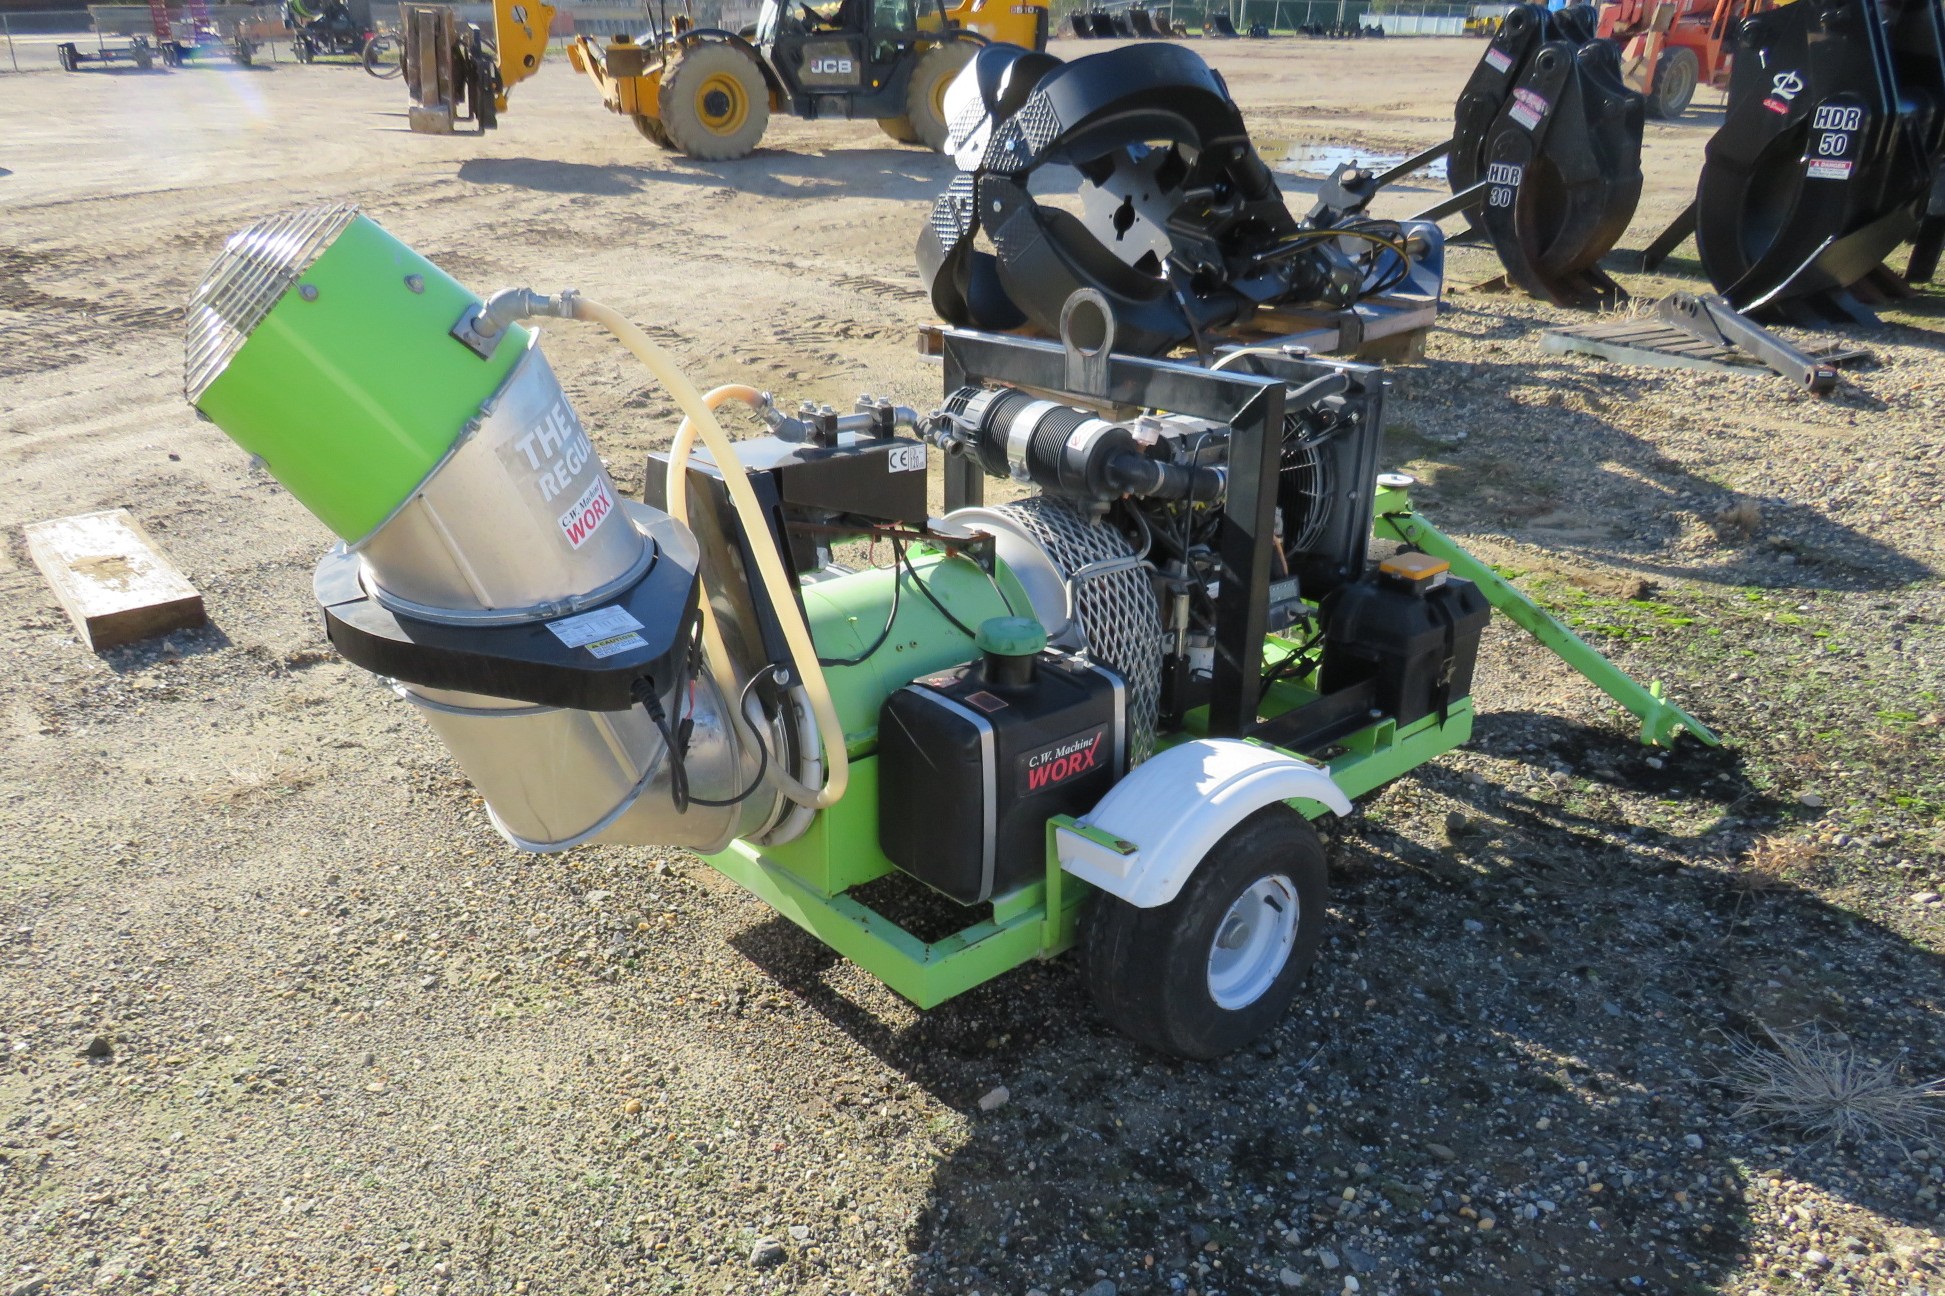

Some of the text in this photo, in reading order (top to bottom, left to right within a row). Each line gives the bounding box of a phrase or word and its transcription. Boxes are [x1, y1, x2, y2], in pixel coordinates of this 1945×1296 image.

[811, 59, 852, 74] JCB
[1813, 106, 1861, 131] HDR
[1818, 133, 1848, 156] 50
[1488, 163, 1522, 186] HDR
[1490, 187, 1511, 207] 30
[515, 402, 572, 470] THE
[890, 451, 907, 469] CE
[566, 480, 610, 545] WORX
[599, 633, 634, 646] CAUTION
[1029, 738, 1094, 768] C.W. Machine
[1029, 732, 1102, 790] WORX
